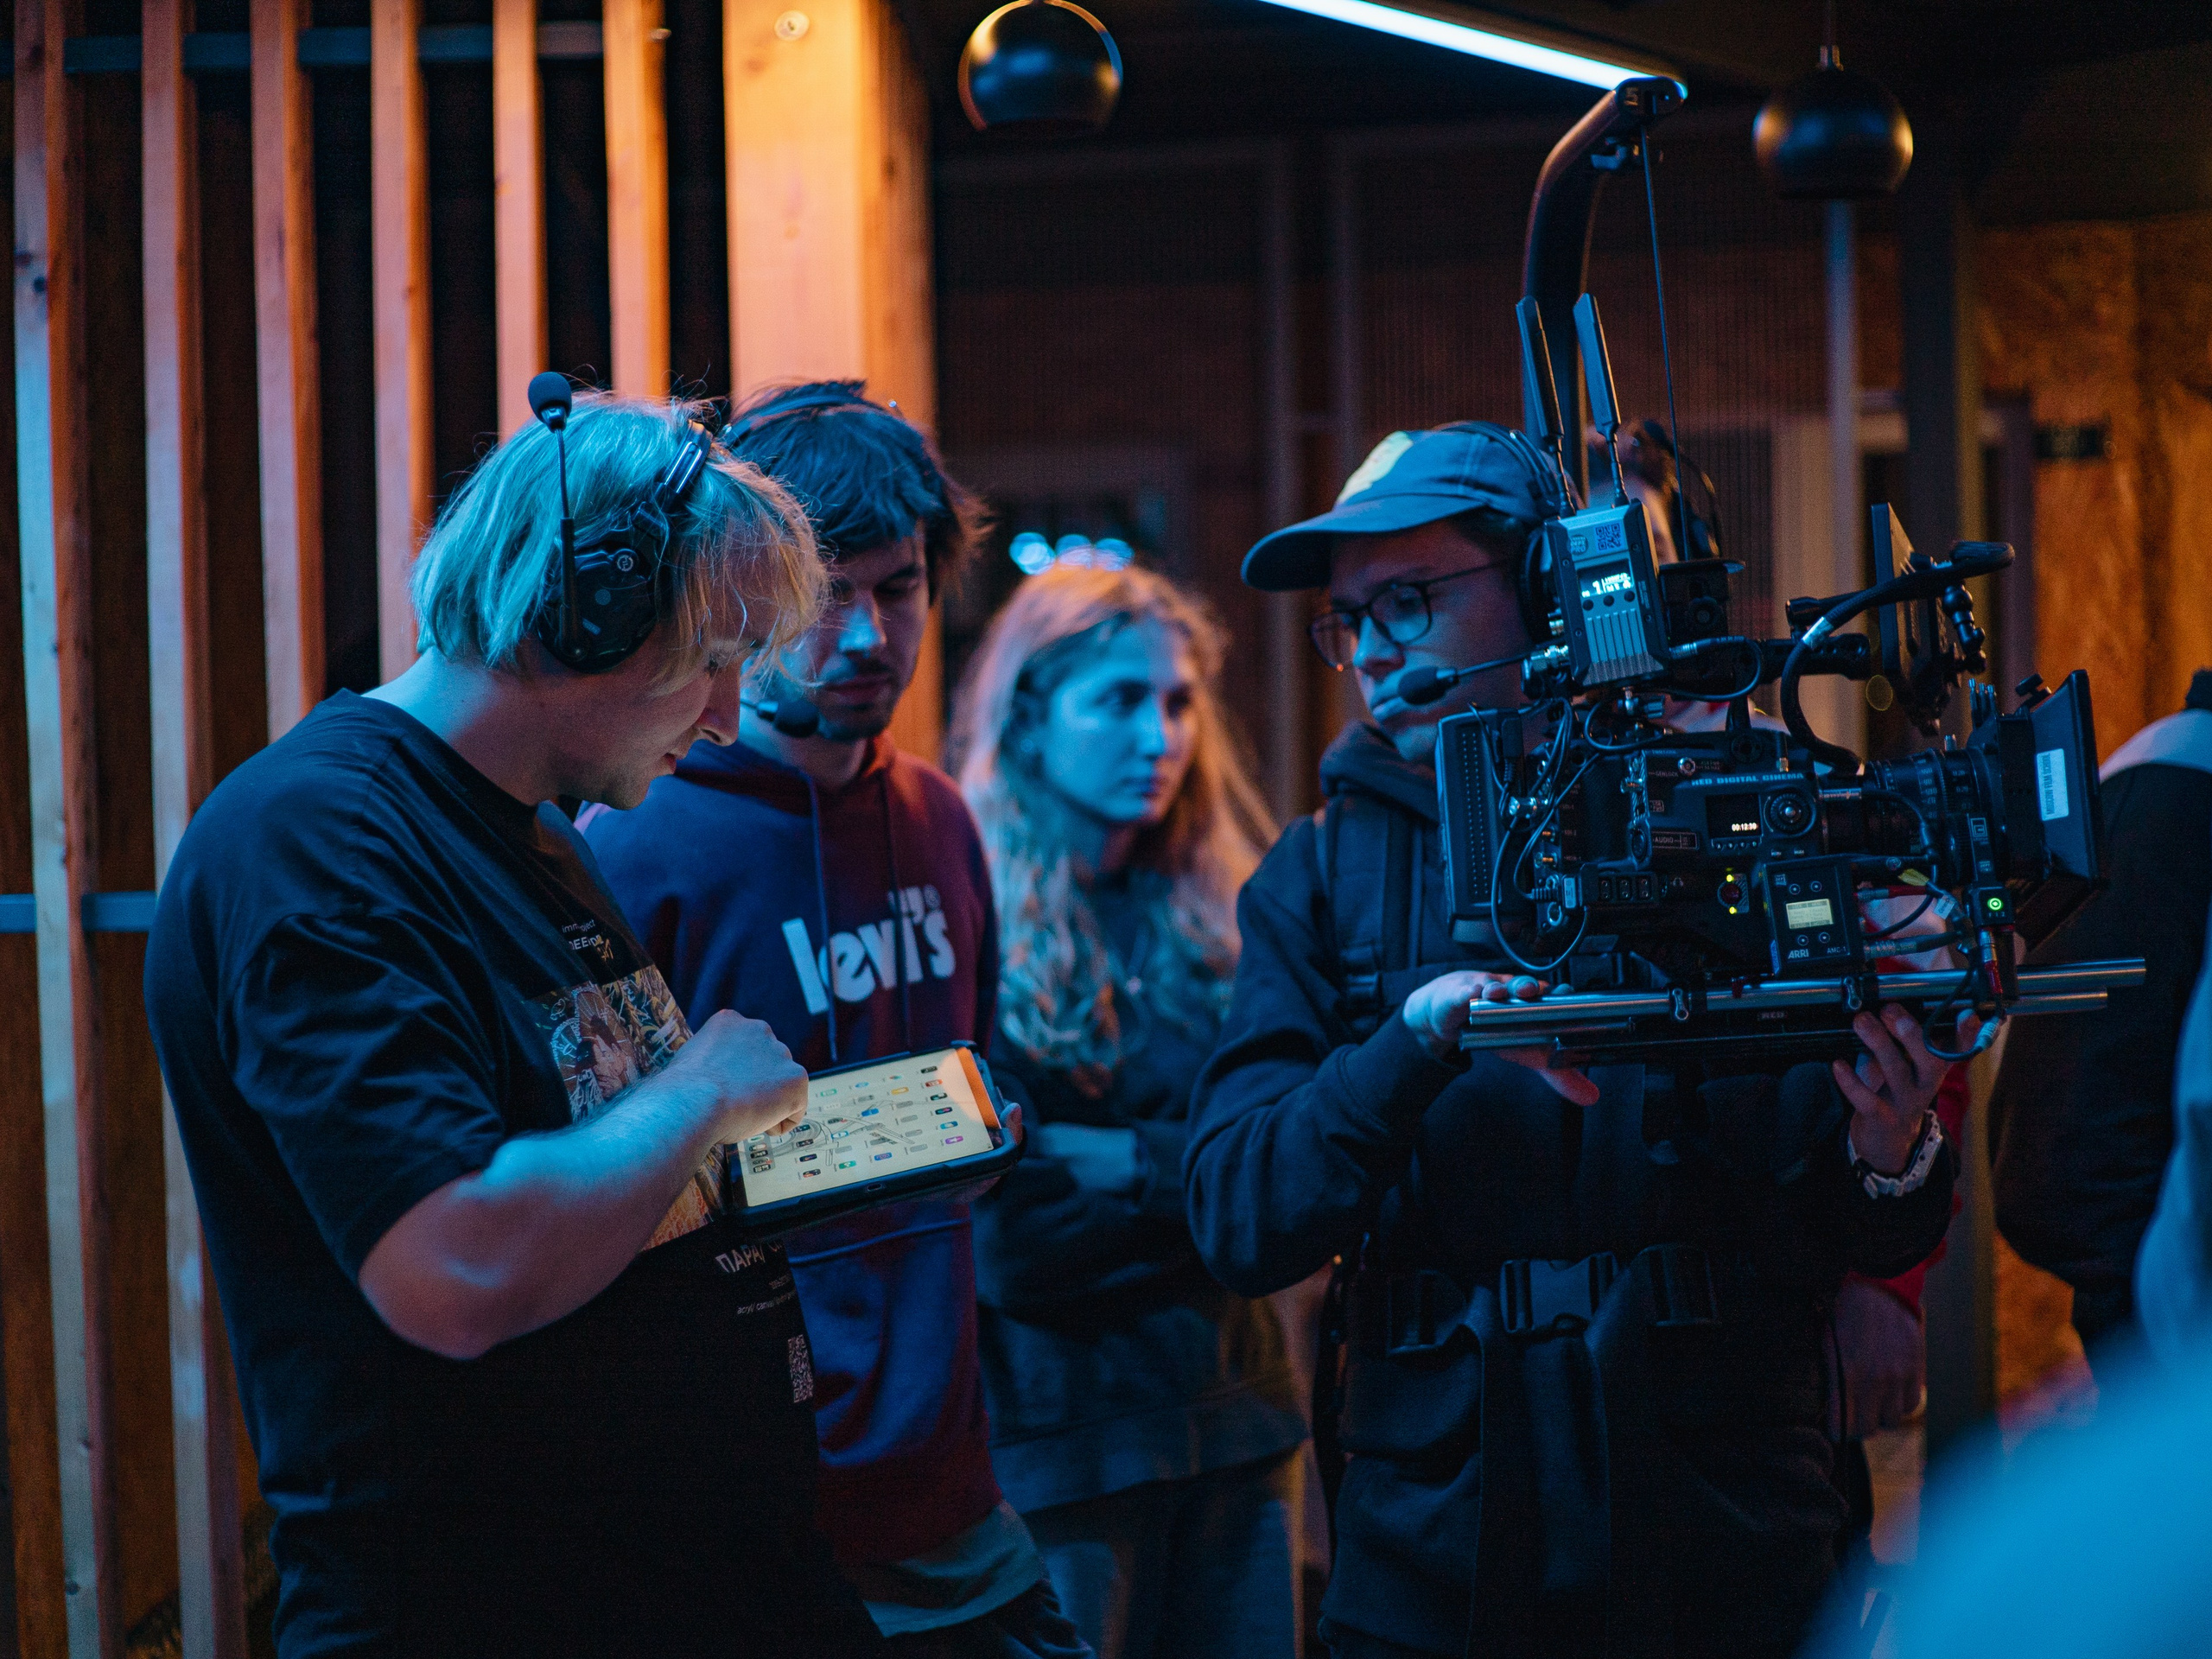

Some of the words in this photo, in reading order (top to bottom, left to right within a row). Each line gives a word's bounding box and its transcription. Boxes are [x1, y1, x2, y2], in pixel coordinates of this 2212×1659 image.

[1691, 778, 1713, 786] RED
[1716, 775, 1759, 785] DIGITAL
[1762, 772, 1804, 781] CINEMA
[1787, 949, 1809, 959] ARRI
